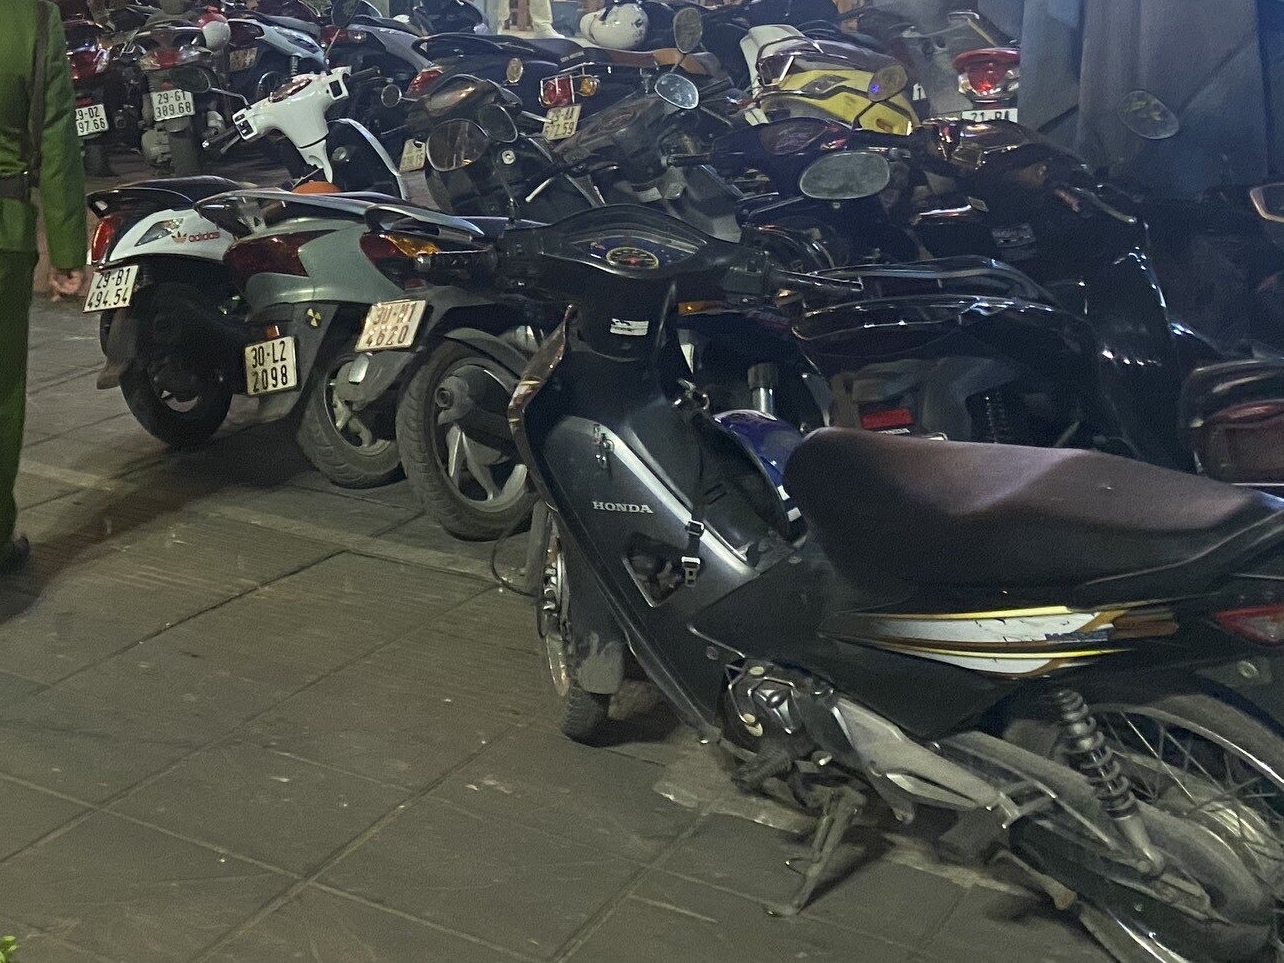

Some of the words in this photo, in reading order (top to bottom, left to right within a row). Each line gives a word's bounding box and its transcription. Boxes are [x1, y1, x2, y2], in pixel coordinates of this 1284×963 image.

[188, 231, 220, 242] adidas
[96, 268, 131, 289] 29-B1
[88, 288, 128, 309] 494.54
[251, 340, 286, 369] 30-L2
[252, 364, 288, 393] 2098
[592, 501, 654, 514] HONDA
